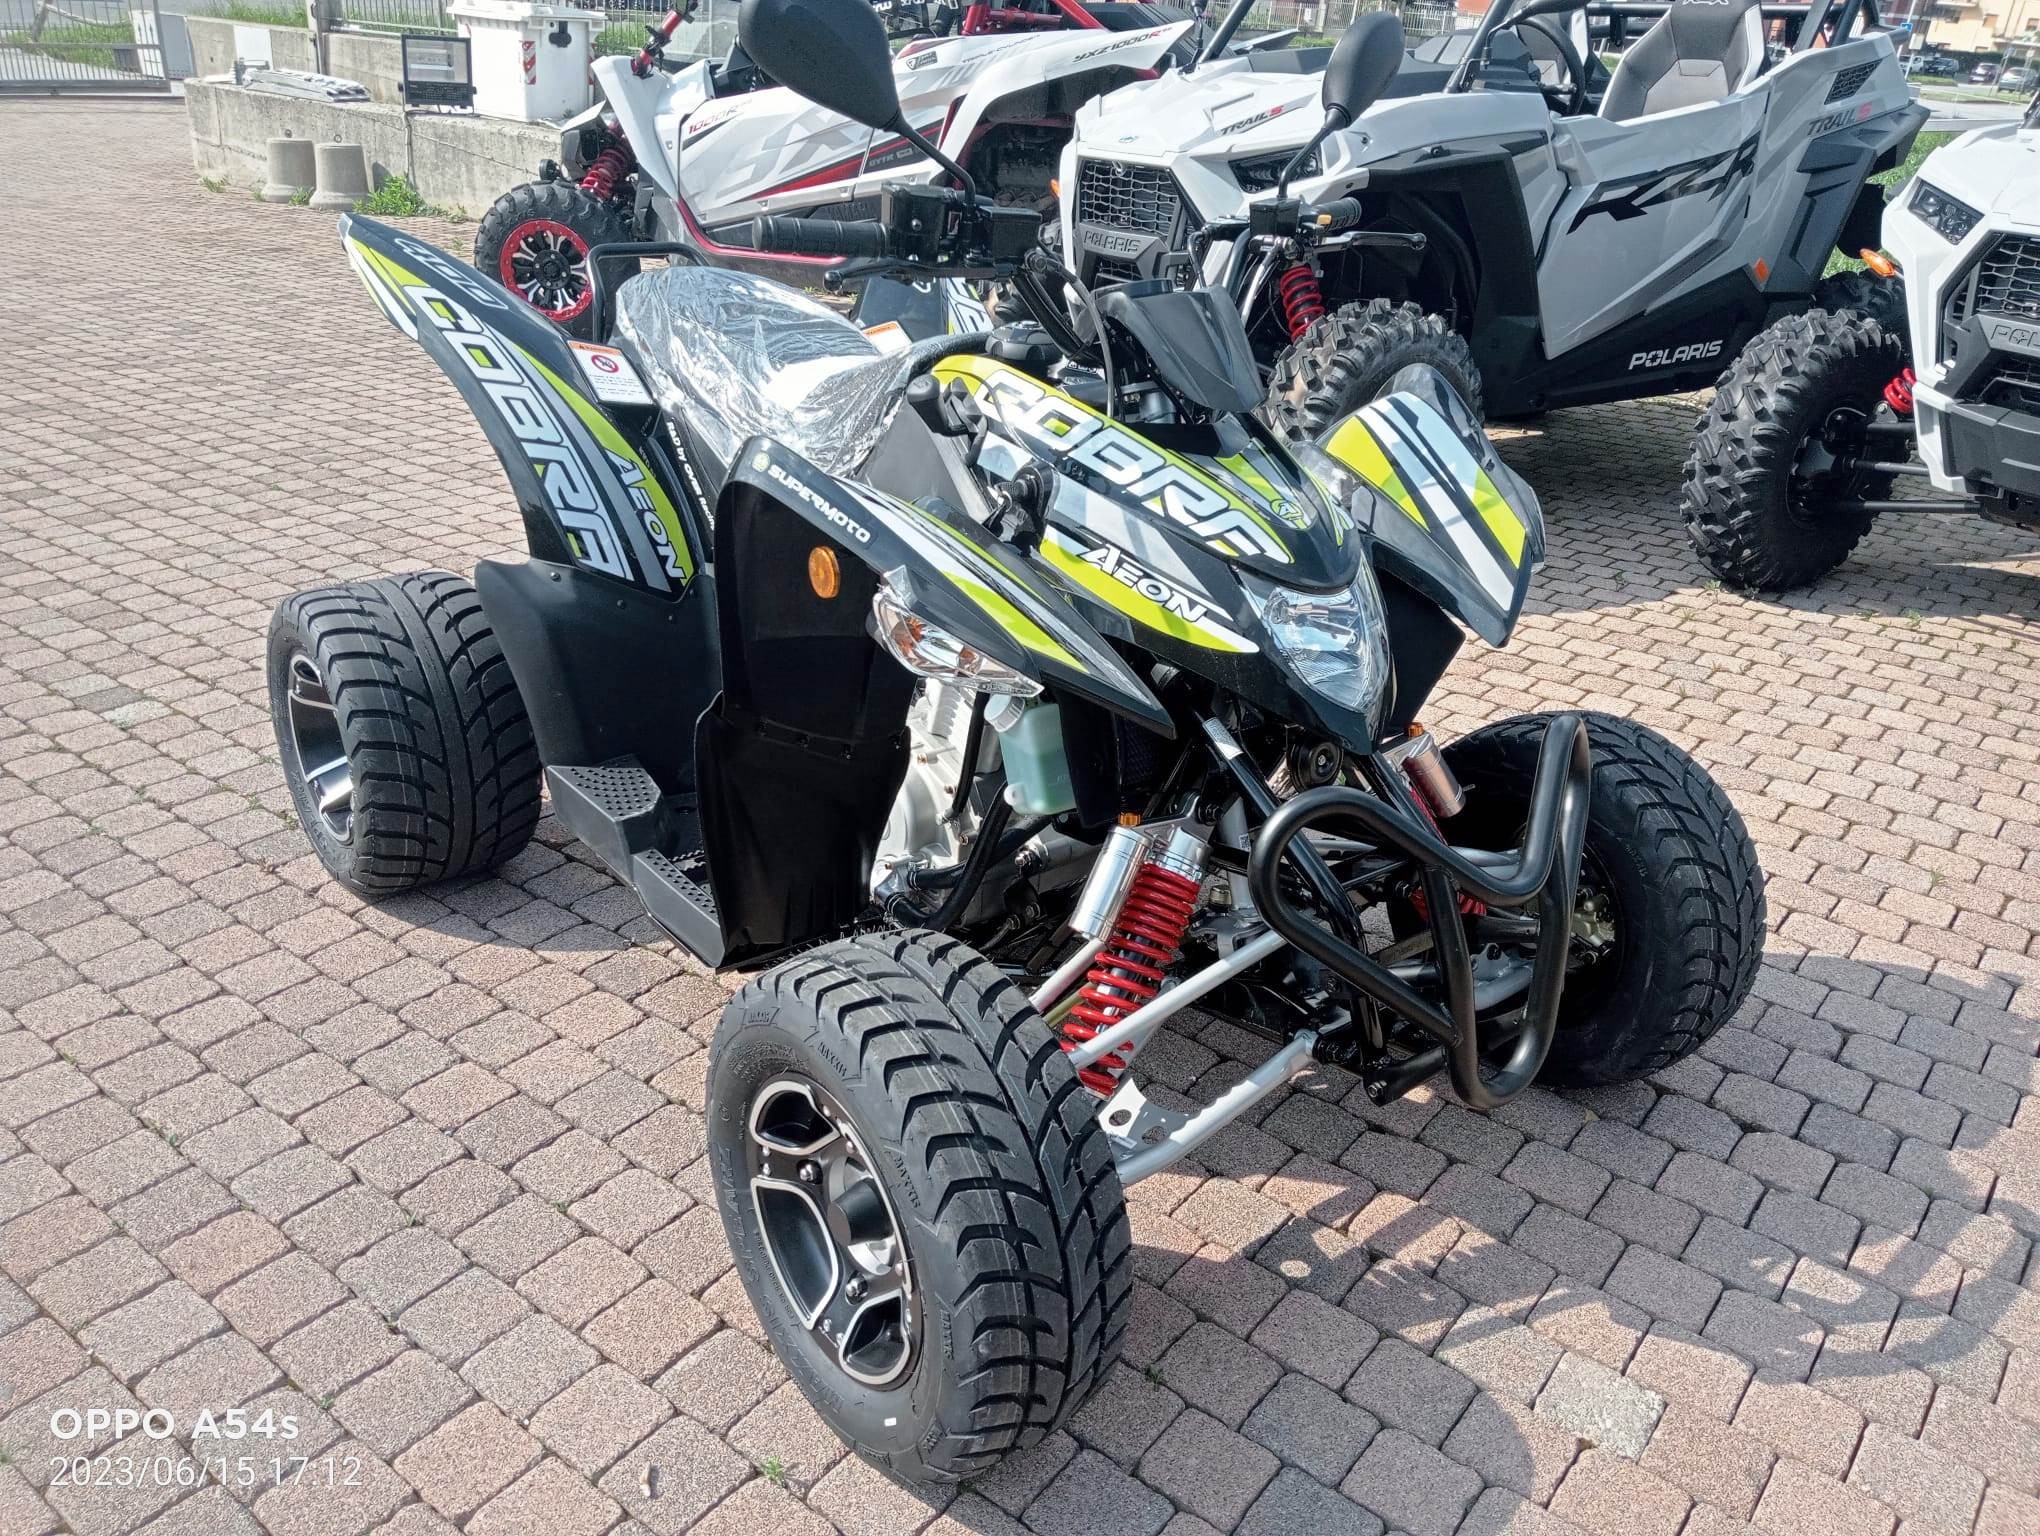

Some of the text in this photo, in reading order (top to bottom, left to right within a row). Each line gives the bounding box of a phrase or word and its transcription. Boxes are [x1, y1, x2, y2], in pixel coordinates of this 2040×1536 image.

[1220, 112, 1268, 136] TRAIL
[1806, 108, 1857, 136] TRAIL
[1083, 230, 1141, 253] POLARIS
[1627, 339, 1723, 371] POLARIS
[400, 284, 634, 584] COBRA
[667, 421, 681, 447] R&D
[676, 447, 688, 462] by
[683, 463, 703, 496] OVER
[971, 368, 1293, 565] COBRA
[605, 448, 688, 580] AEON
[767, 464, 871, 543] SUPERMOTO
[1077, 543, 1208, 623] AEON
